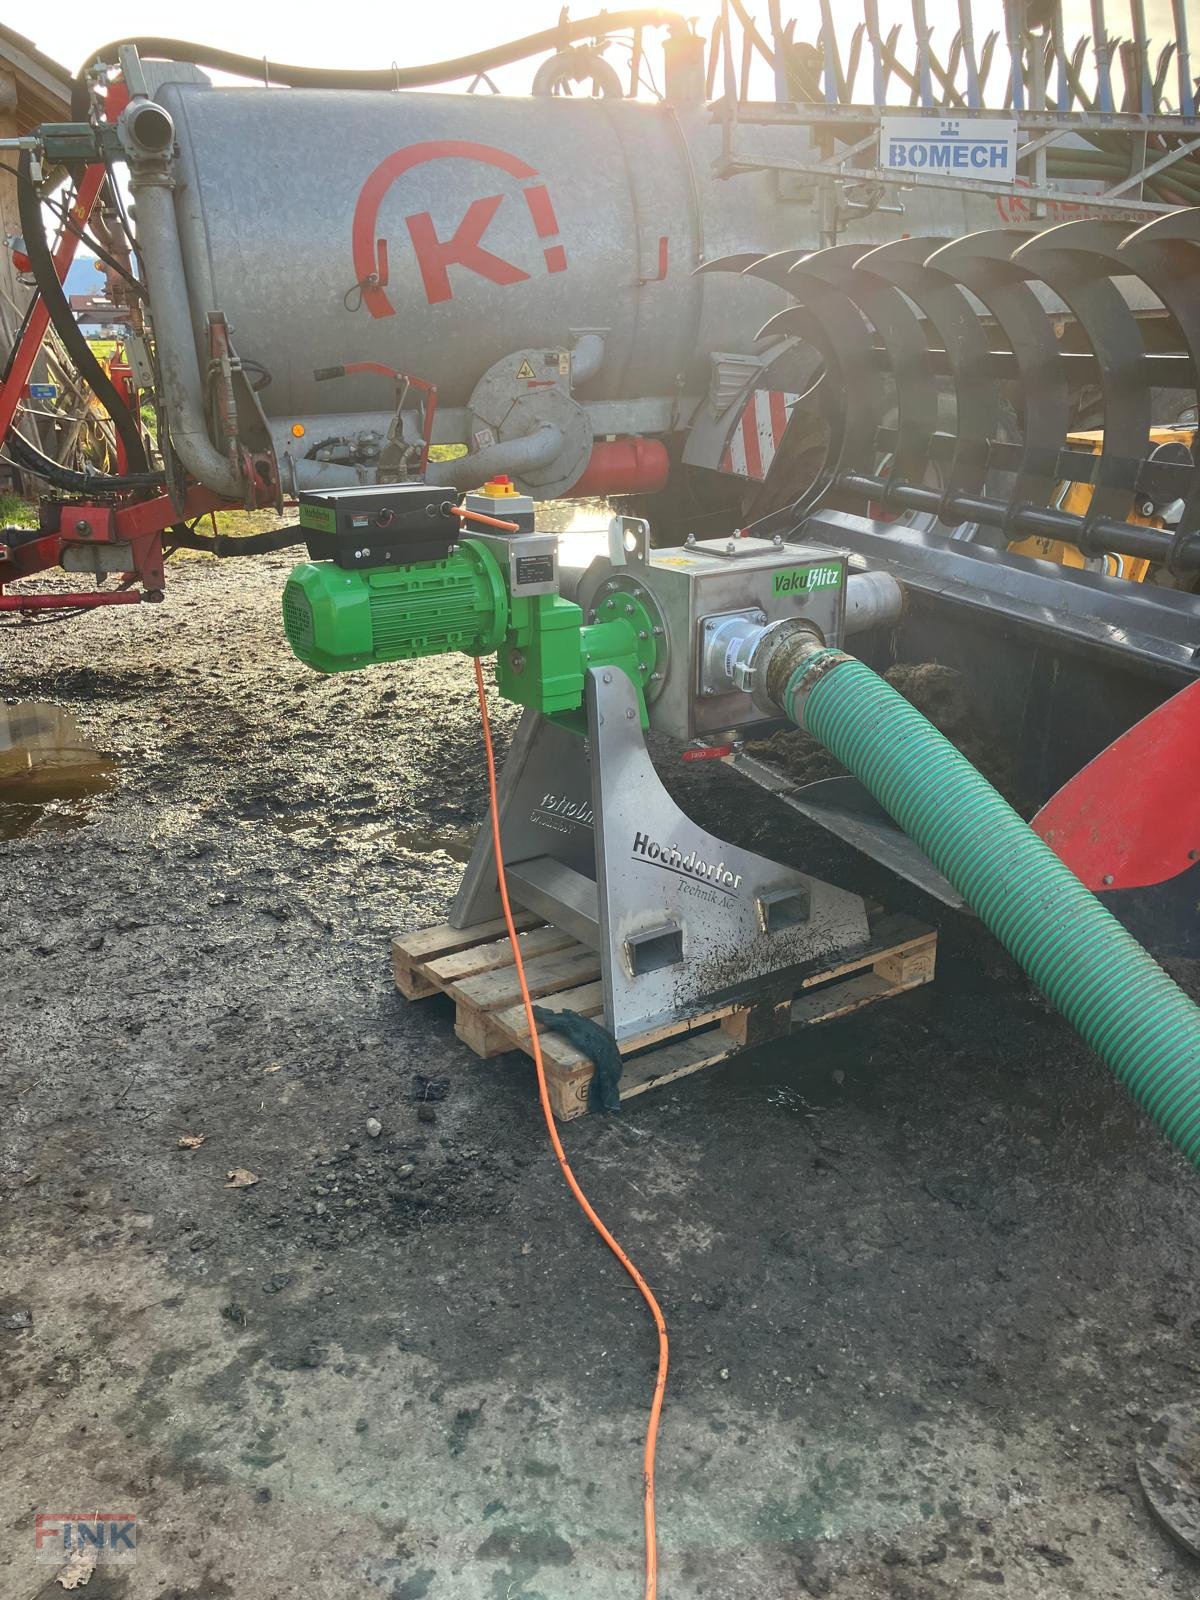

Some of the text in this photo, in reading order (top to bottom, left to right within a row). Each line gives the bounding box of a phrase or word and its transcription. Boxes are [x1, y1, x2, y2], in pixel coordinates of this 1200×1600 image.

[888, 144, 1008, 169] BOMECH
[775, 567, 839, 592] VakuBlitz
[632, 831, 743, 890] Hochdorfer
[678, 880, 736, 910] Technik AG
